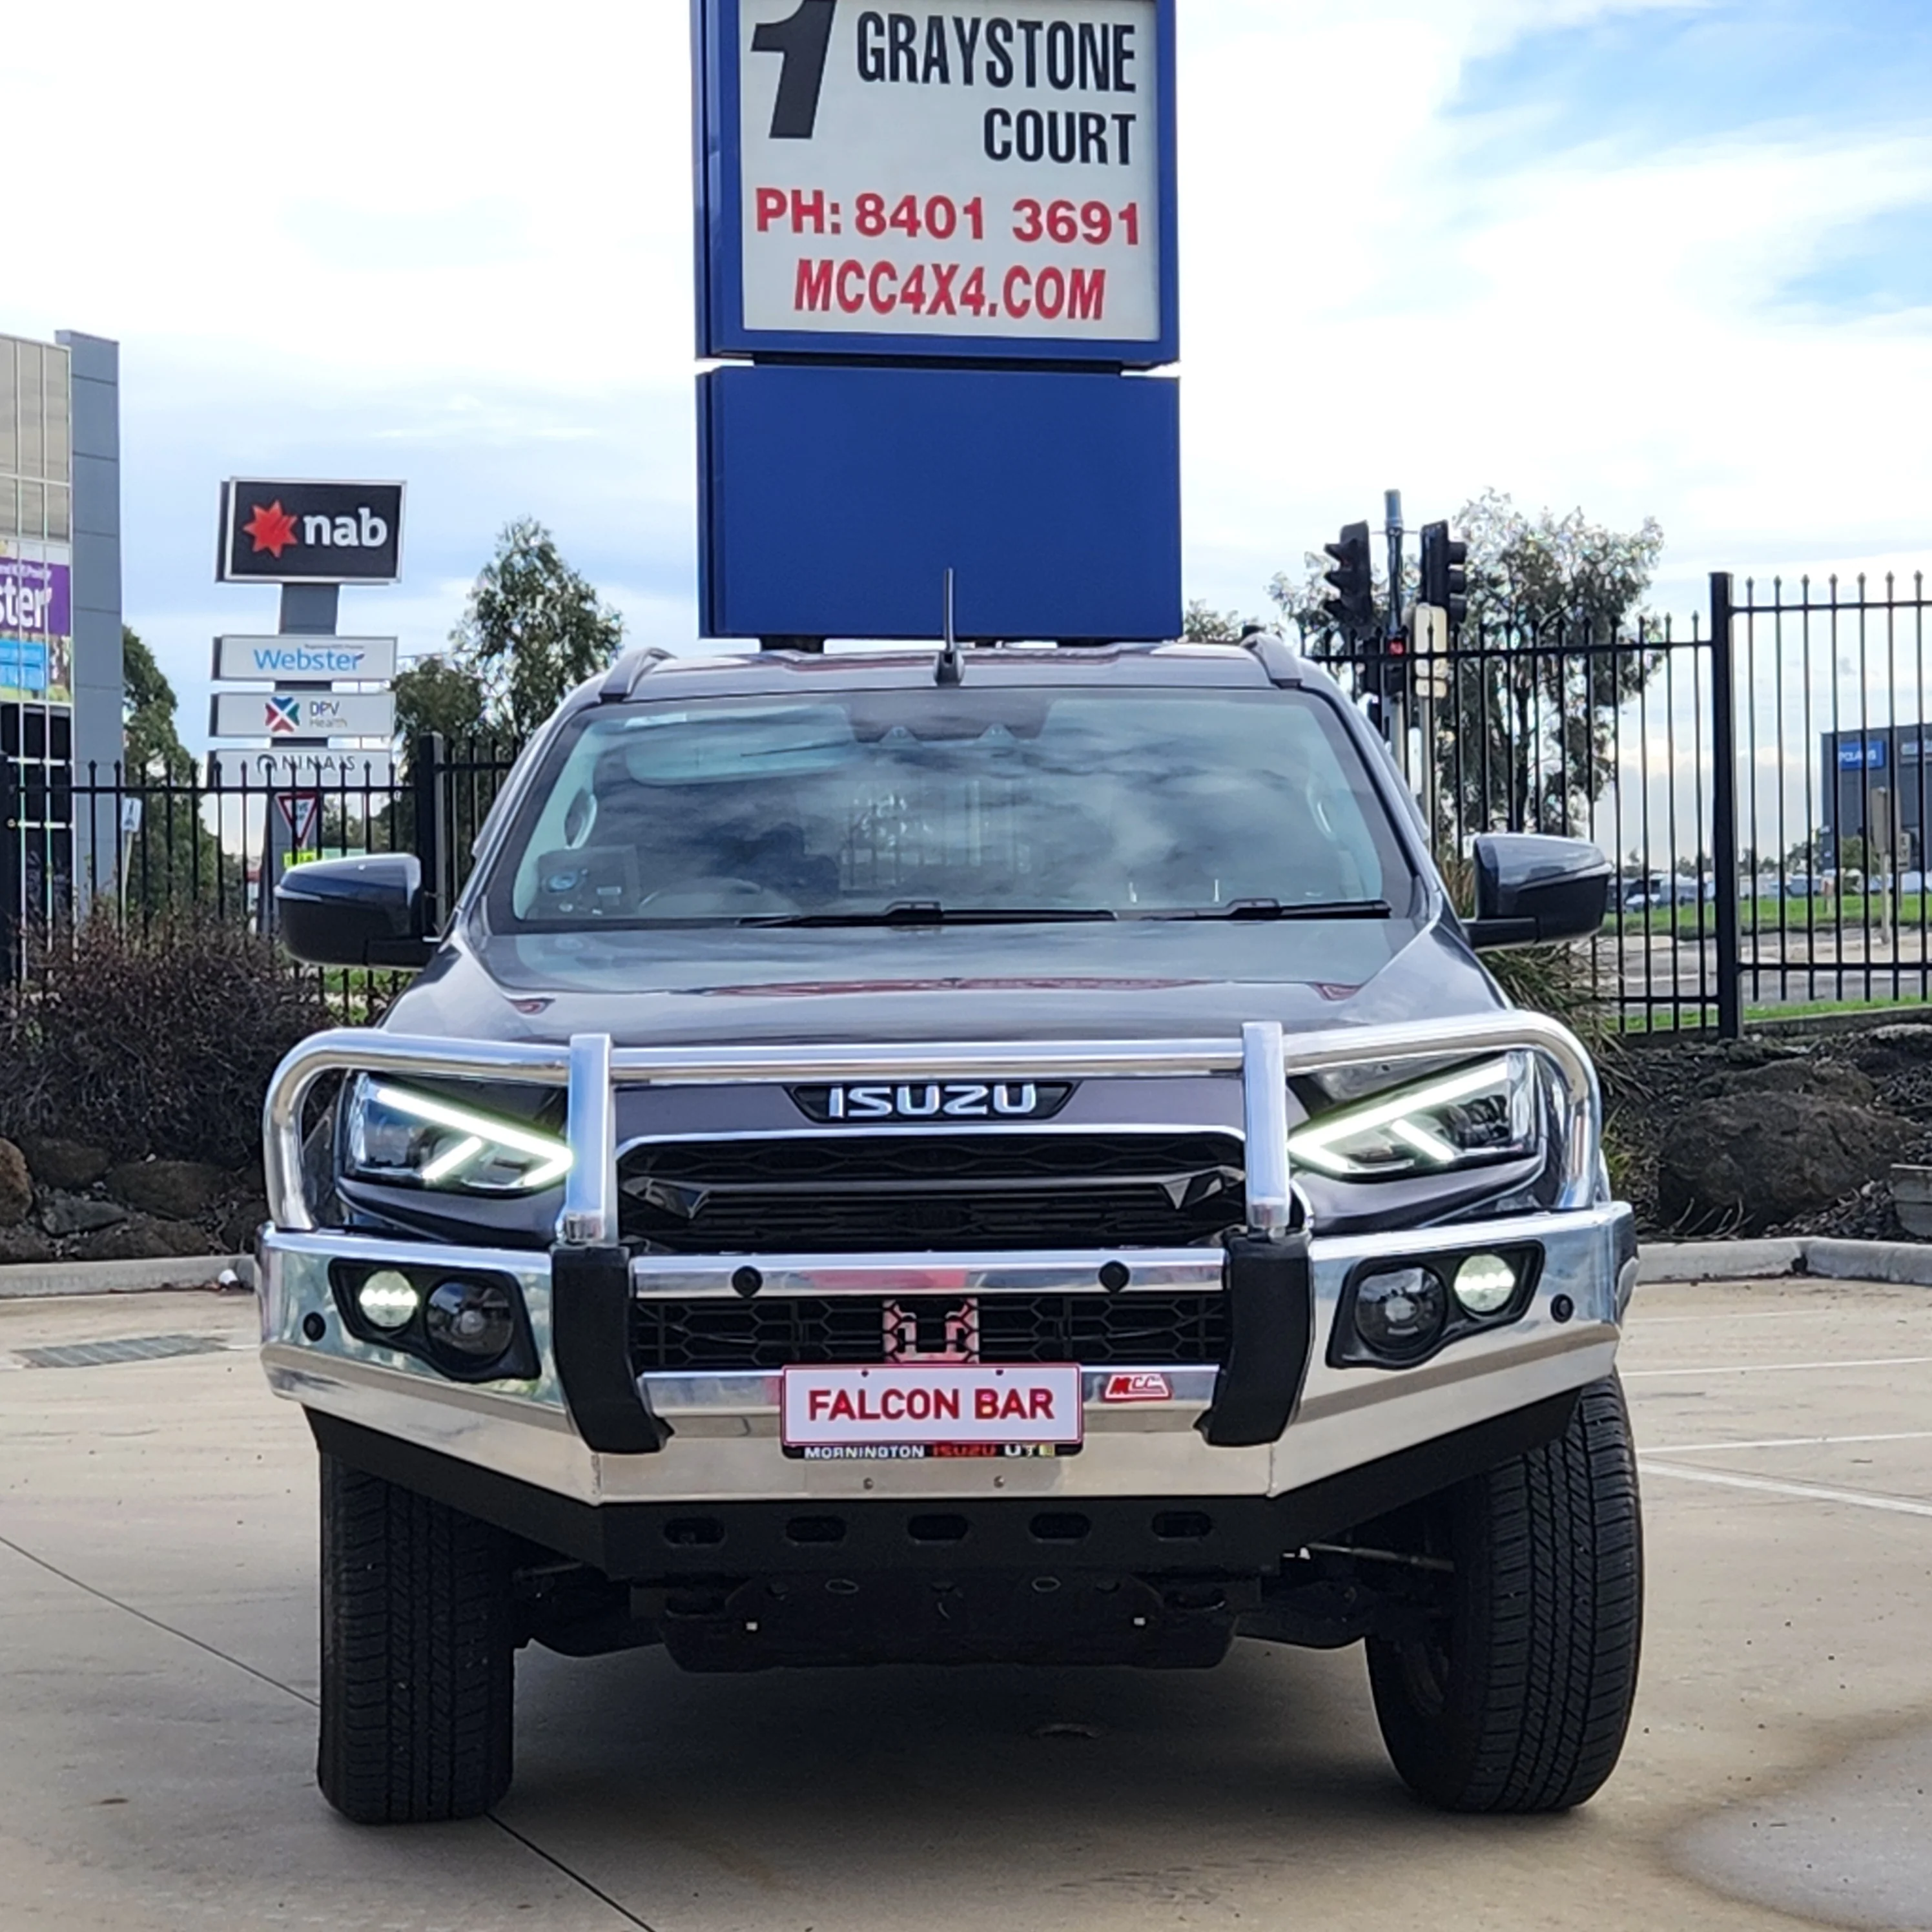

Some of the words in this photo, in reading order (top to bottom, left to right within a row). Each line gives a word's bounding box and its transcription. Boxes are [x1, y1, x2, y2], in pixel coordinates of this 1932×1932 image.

[750, 0, 838, 139] 1
[857, 11, 1136, 93] GRAYSTONE
[983, 108, 1136, 165] COURT
[755, 187, 841, 234] PH:
[855, 192, 983, 240] 8401
[1012, 199, 1139, 245] 3691
[794, 258, 1106, 320] MCC4X4.COM
[303, 507, 387, 548] nab
[253, 648, 365, 672] Webster
[310, 701, 340, 717] DPV
[829, 1083, 1036, 1118] ISUZU
[808, 1389, 960, 1421] FALCON
[974, 1388, 1055, 1420] BAR
[804, 1445, 925, 1459] MORNINGTON
[932, 1444, 996, 1458] ISUZU
